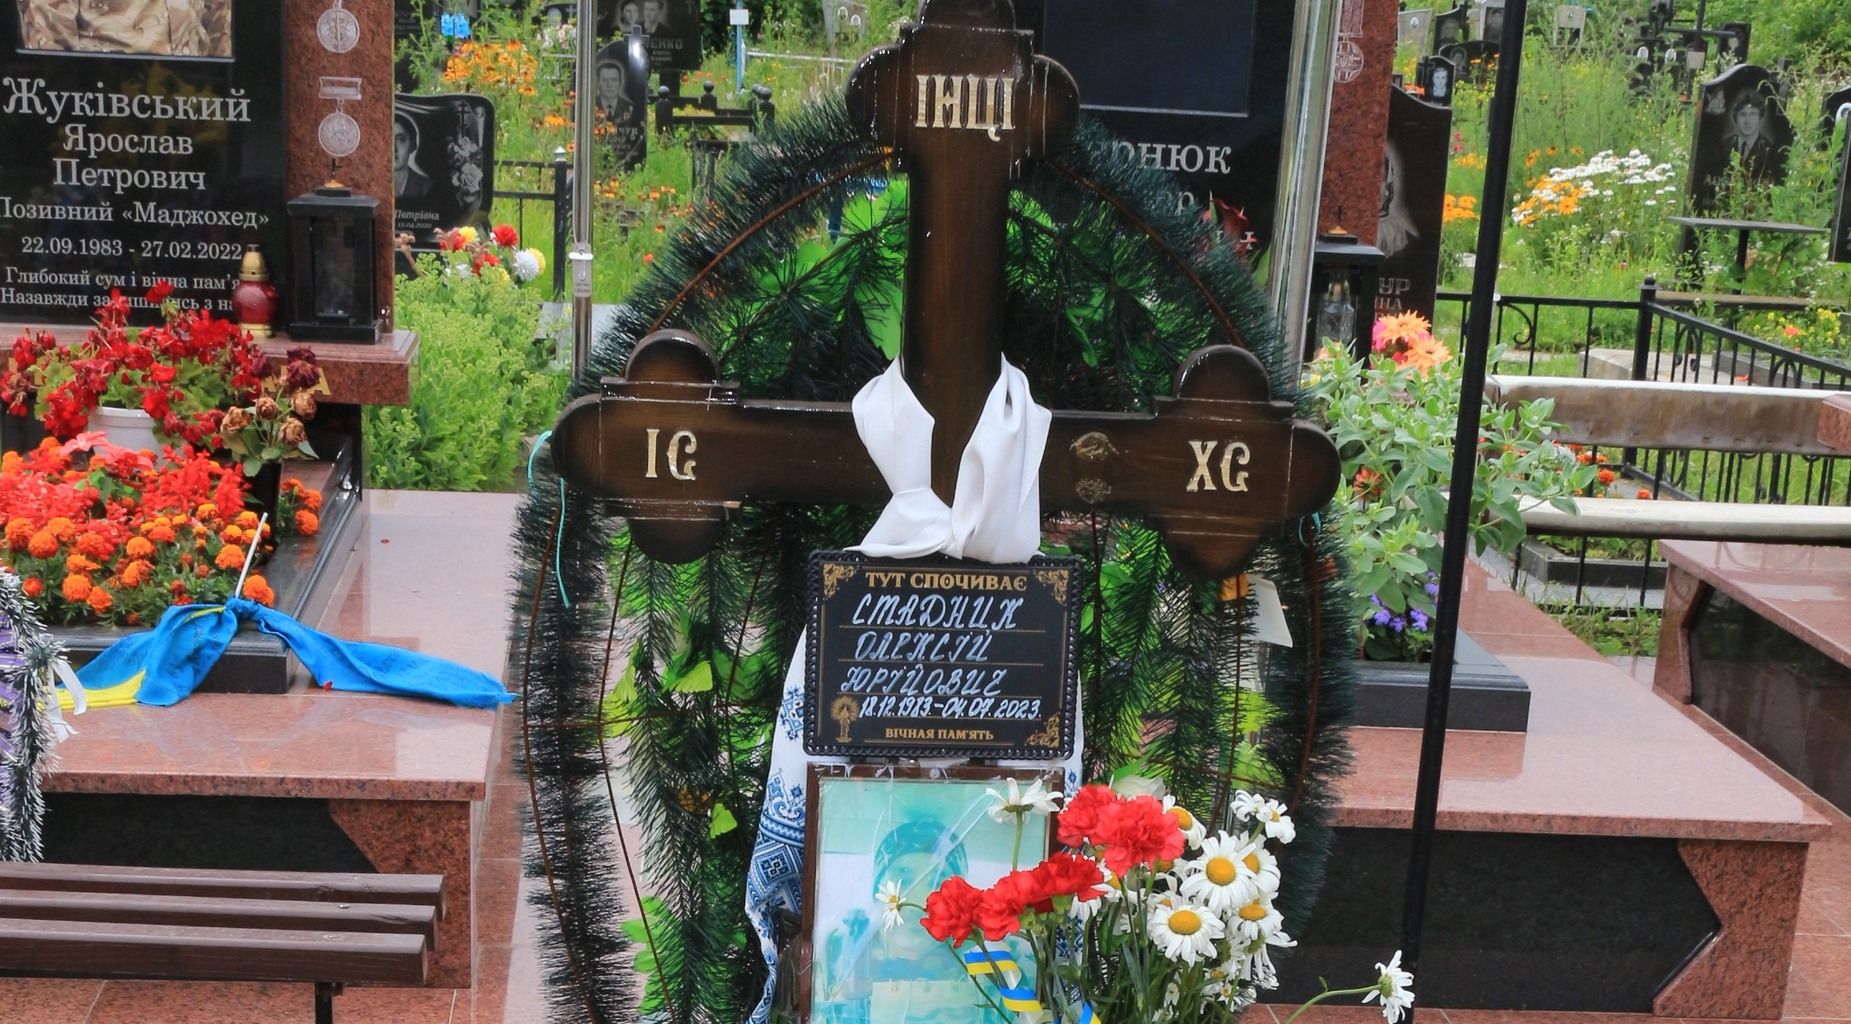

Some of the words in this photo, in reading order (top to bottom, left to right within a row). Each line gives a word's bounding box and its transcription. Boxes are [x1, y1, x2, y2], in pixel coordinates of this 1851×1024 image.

[2, 77, 251, 123] Жуківський
[62, 123, 194, 158] Ярослав
[52, 158, 206, 194] Петрович
[122, 201, 269, 231] «Маджохед»
[21, 236, 123, 256] 22.09.1983
[141, 240, 242, 260] 27.02.2022
[5, 266, 91, 286] Глибокий
[95, 273, 126, 290] сум
[131, 271, 137, 288] і
[0, 287, 89, 308] Назавжди
[865, 572, 906, 588] ТУТ
[910, 573, 1027, 591] СПОЧИВАЄ
[885, 728, 935, 739] ВІЧНАЯ
[938, 729, 994, 740] ПАМ'ЯТЬ
